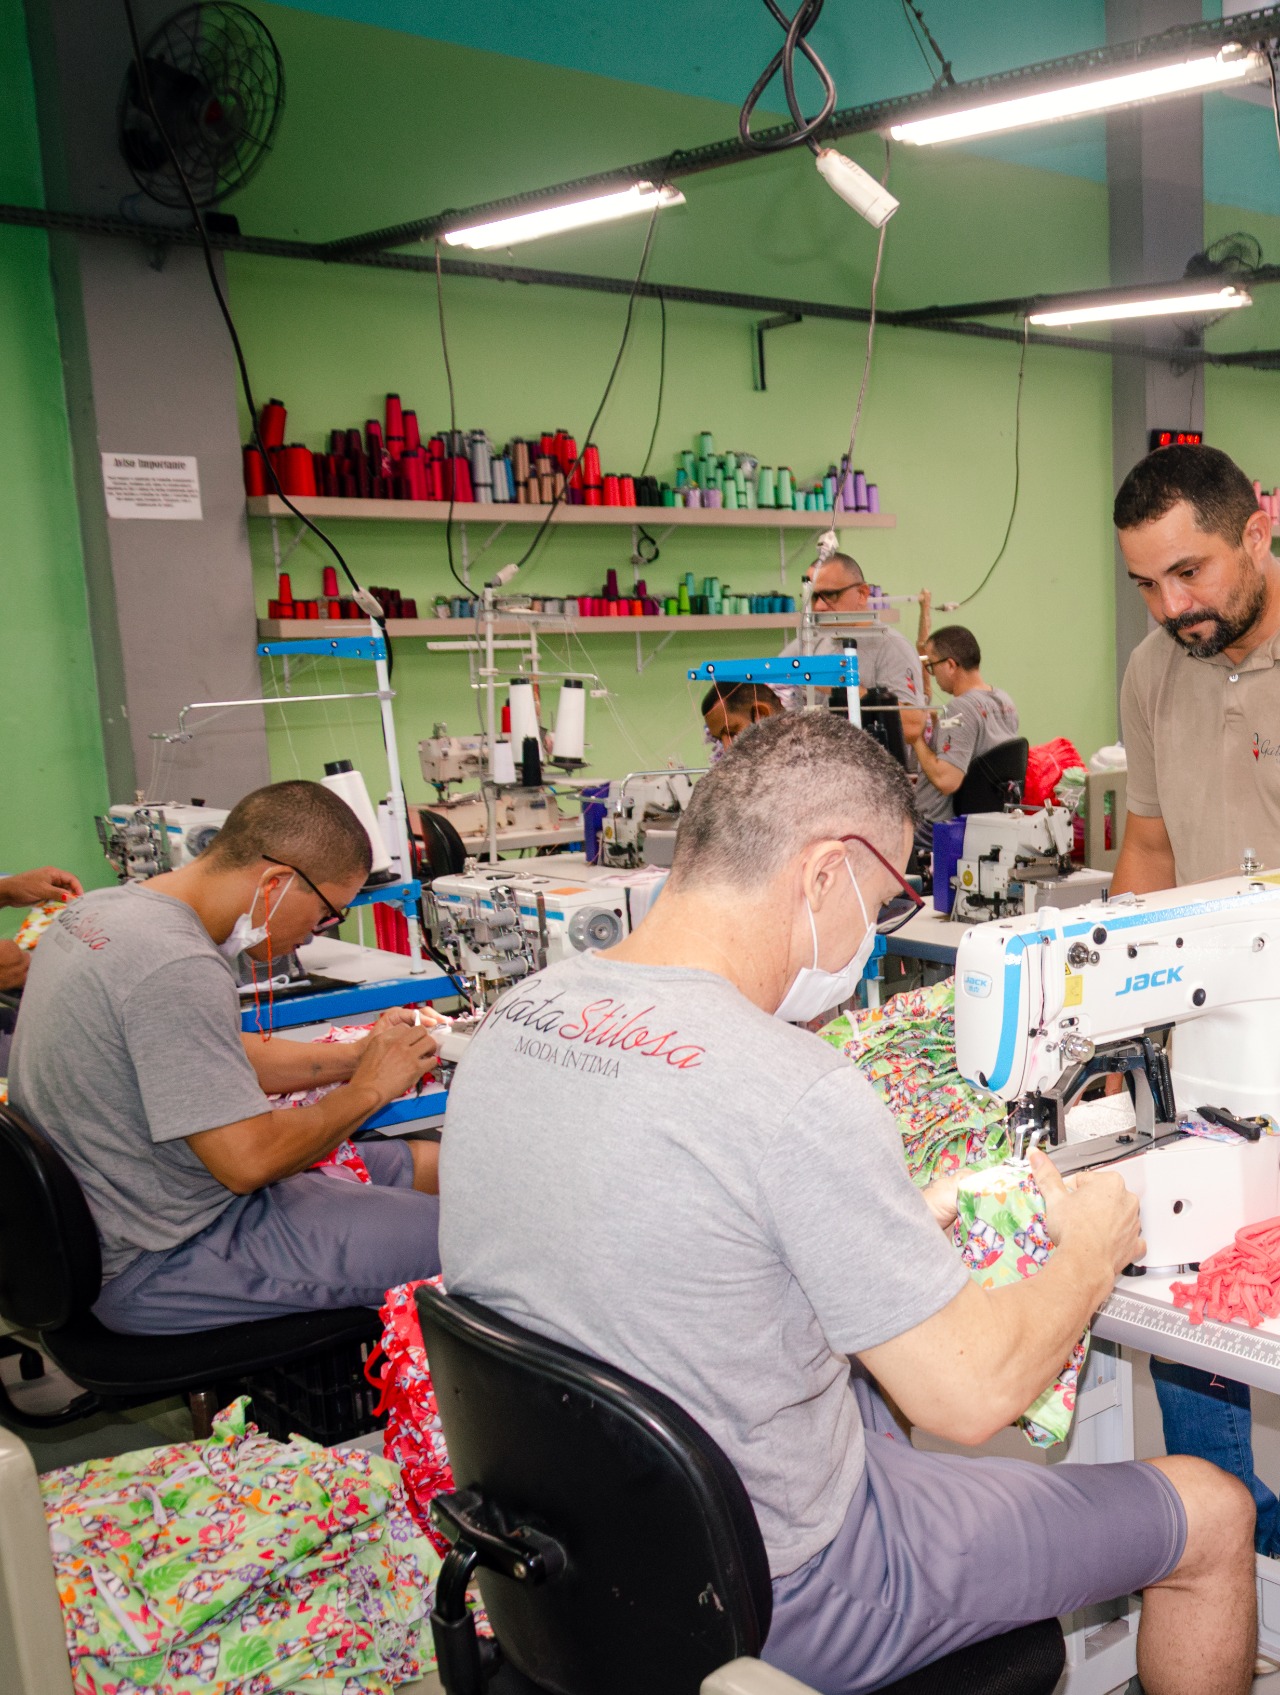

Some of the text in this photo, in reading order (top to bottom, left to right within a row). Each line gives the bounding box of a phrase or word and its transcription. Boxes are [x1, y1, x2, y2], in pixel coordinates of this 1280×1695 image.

[489, 979, 707, 1070] Gata Stilosa
[514, 1035, 621, 1079] MODA ÍNTIMA
